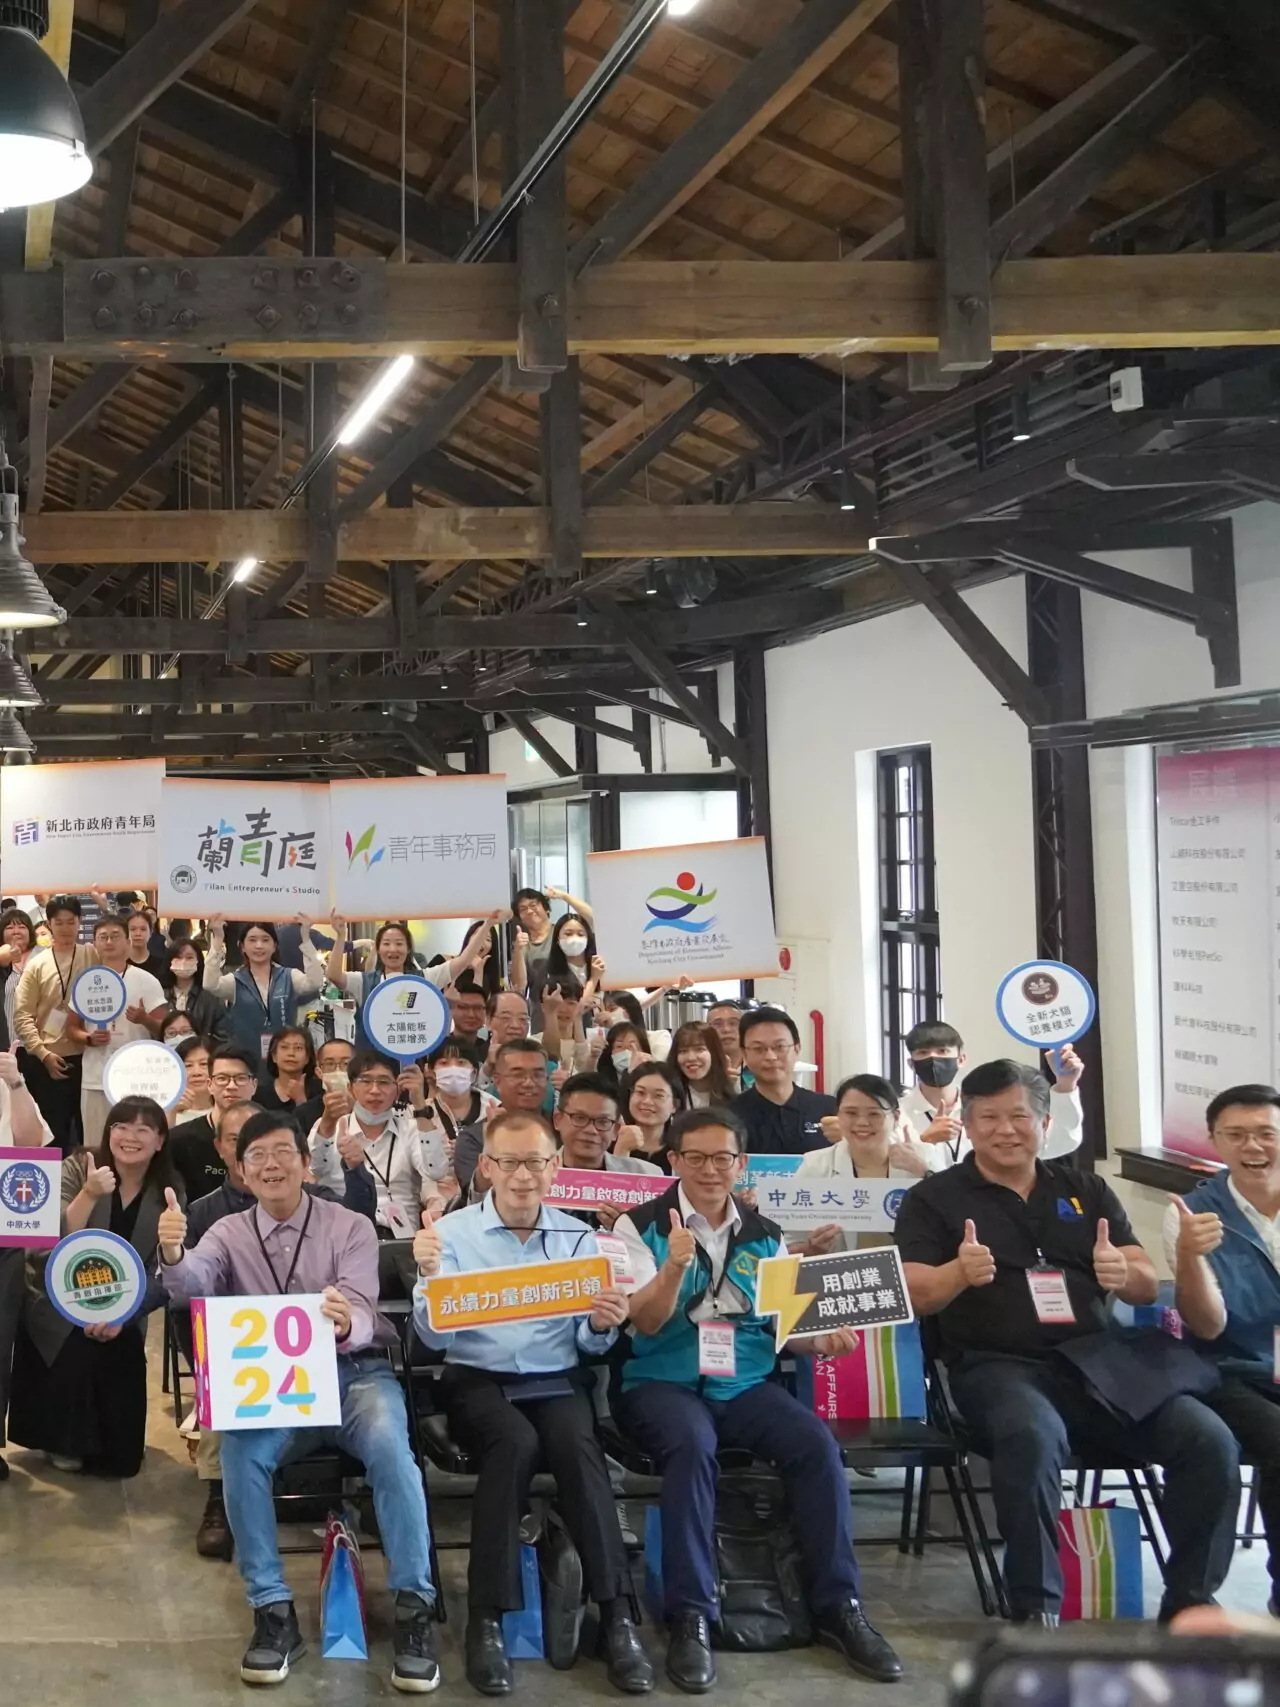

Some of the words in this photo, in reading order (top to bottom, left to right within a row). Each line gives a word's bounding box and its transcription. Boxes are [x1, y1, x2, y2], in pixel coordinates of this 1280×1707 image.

[46, 814, 155, 832] 新北市政府青年局
[388, 833, 496, 864] 青年事務局
[204, 883, 225, 891] Yilan
[292, 886, 321, 895] Studio
[1026, 1006, 1072, 1024] 全新犬貓
[386, 1022, 428, 1033] 太陽能板
[1029, 1018, 1075, 1036] 認養模式
[387, 1034, 428, 1045] 自潔增亮
[204, 1164, 227, 1175] Pac
[768, 1189, 870, 1208] 中原大學
[6, 1220, 40, 1229] 中原大學
[822, 1267, 882, 1293] 用創業
[440, 1276, 603, 1315] 永續力量創新引領
[817, 1289, 897, 1318] 成就事業
[230, 1305, 313, 1359] 20
[233, 1364, 317, 1418] 24
